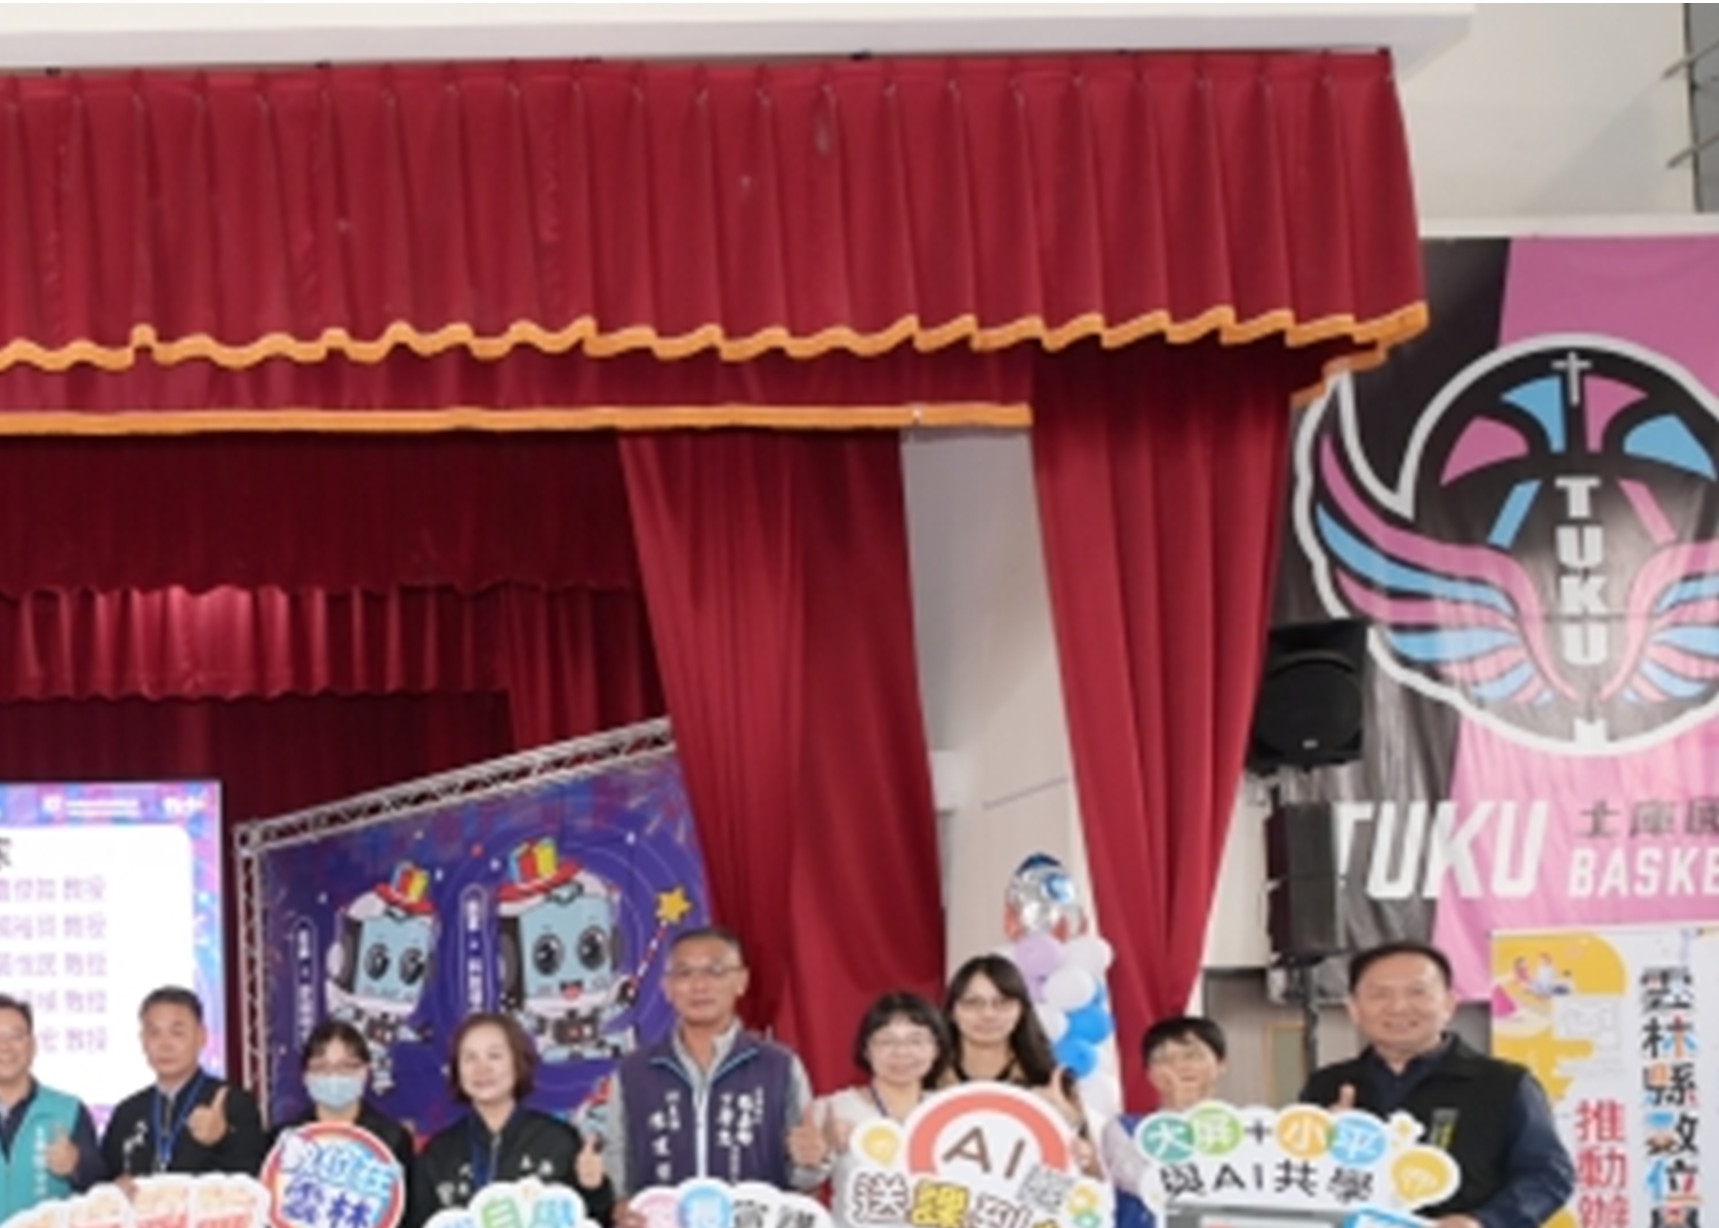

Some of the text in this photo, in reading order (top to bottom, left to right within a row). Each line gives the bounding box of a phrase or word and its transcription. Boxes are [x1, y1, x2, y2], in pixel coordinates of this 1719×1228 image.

[1555, 476, 1605, 667] TUKU
[1332, 801, 1548, 899] TUKU
[942, 1126, 1027, 1181] AI
